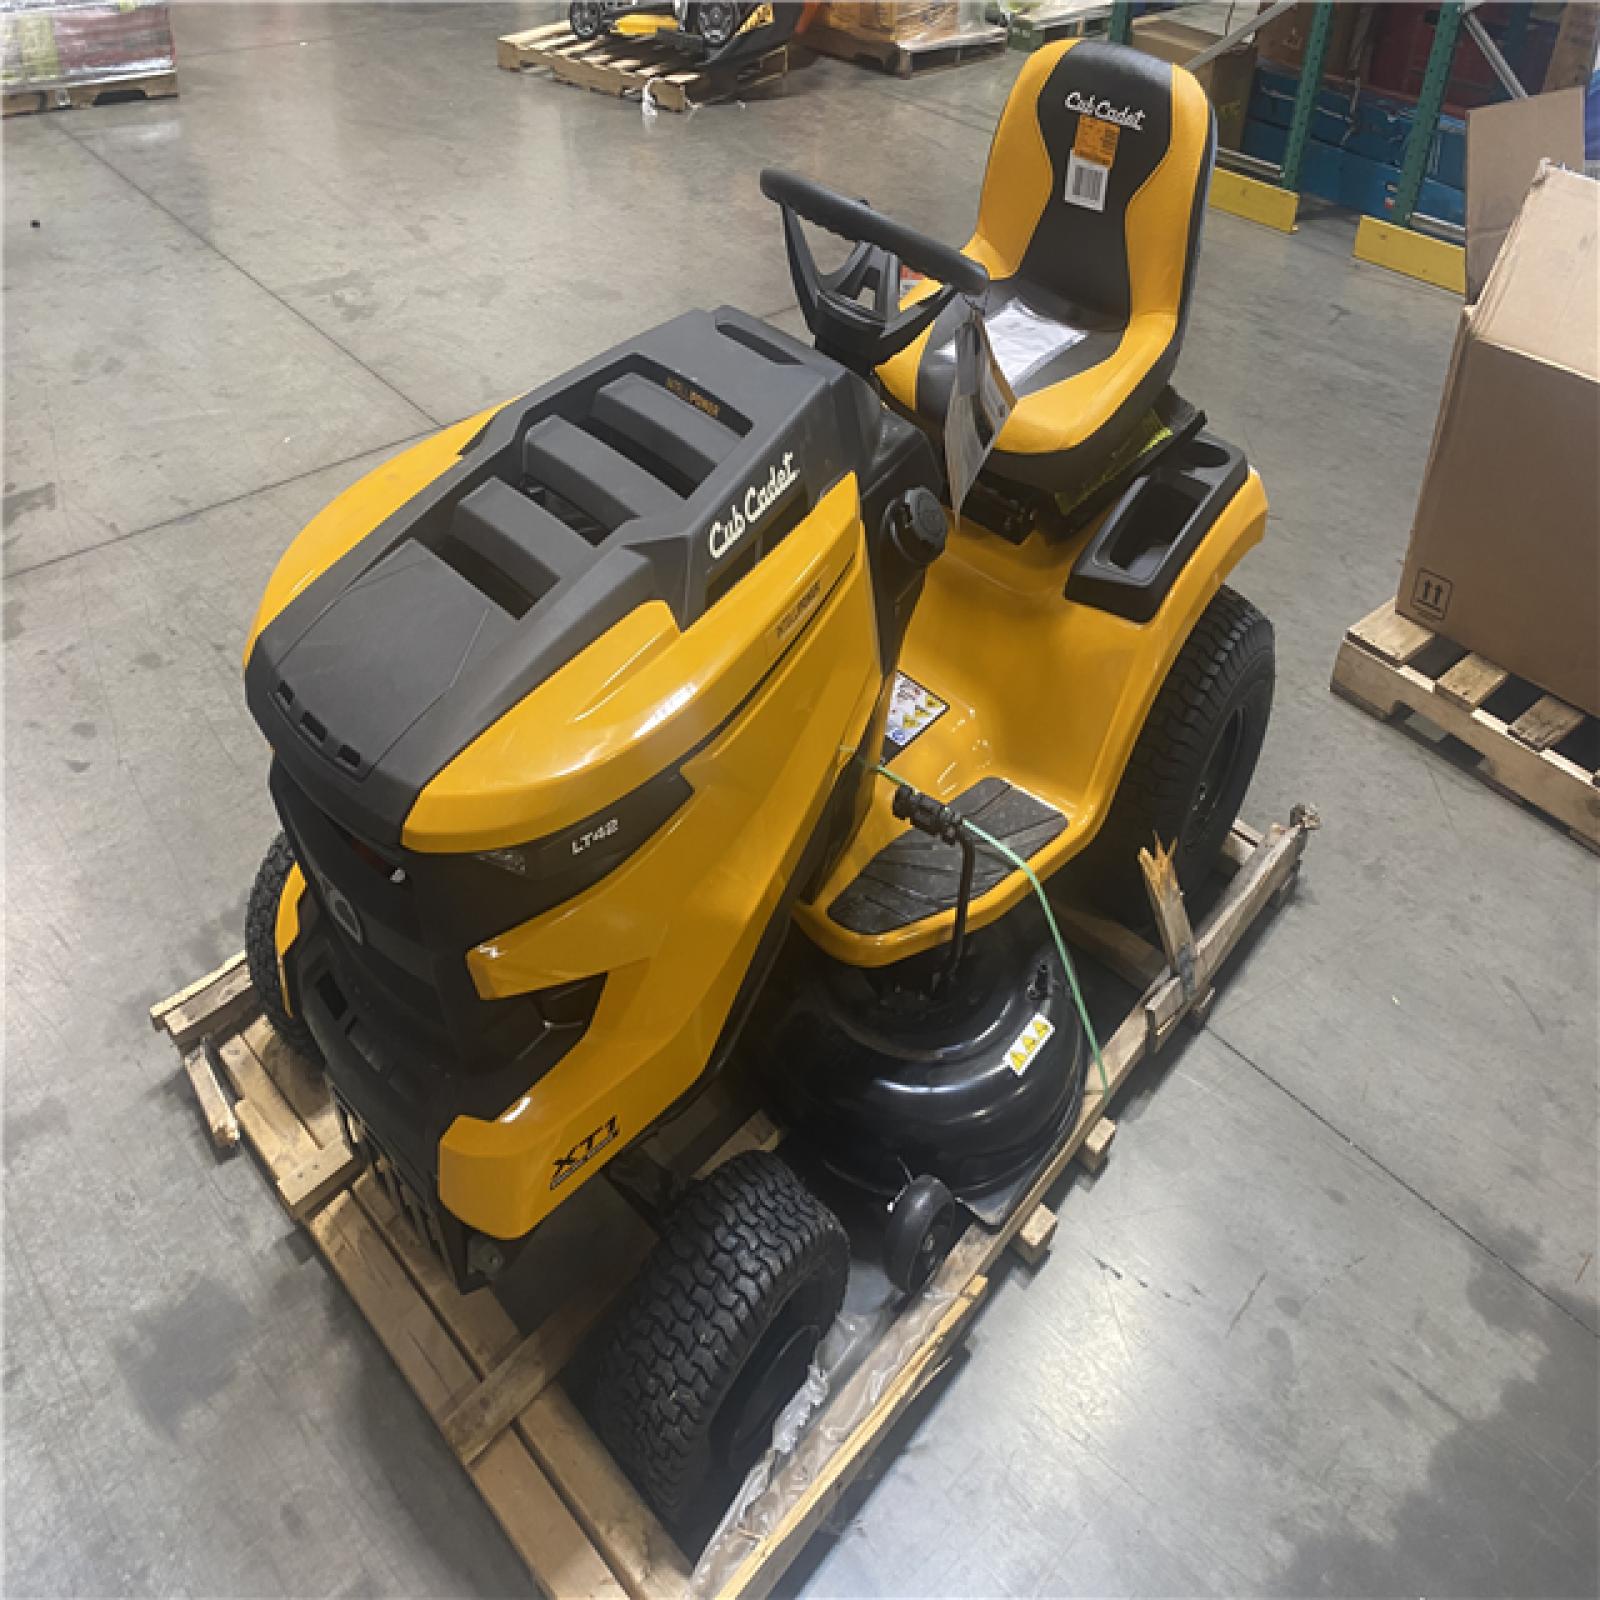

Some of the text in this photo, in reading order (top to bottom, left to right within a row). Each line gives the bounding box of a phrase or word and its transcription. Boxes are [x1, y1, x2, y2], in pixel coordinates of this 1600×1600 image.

[1064, 91, 1146, 131] Cub Cadet
[708, 451, 801, 560] Cub Cadet
[571, 818, 619, 856] LT42
[551, 1112, 619, 1180] XT1
